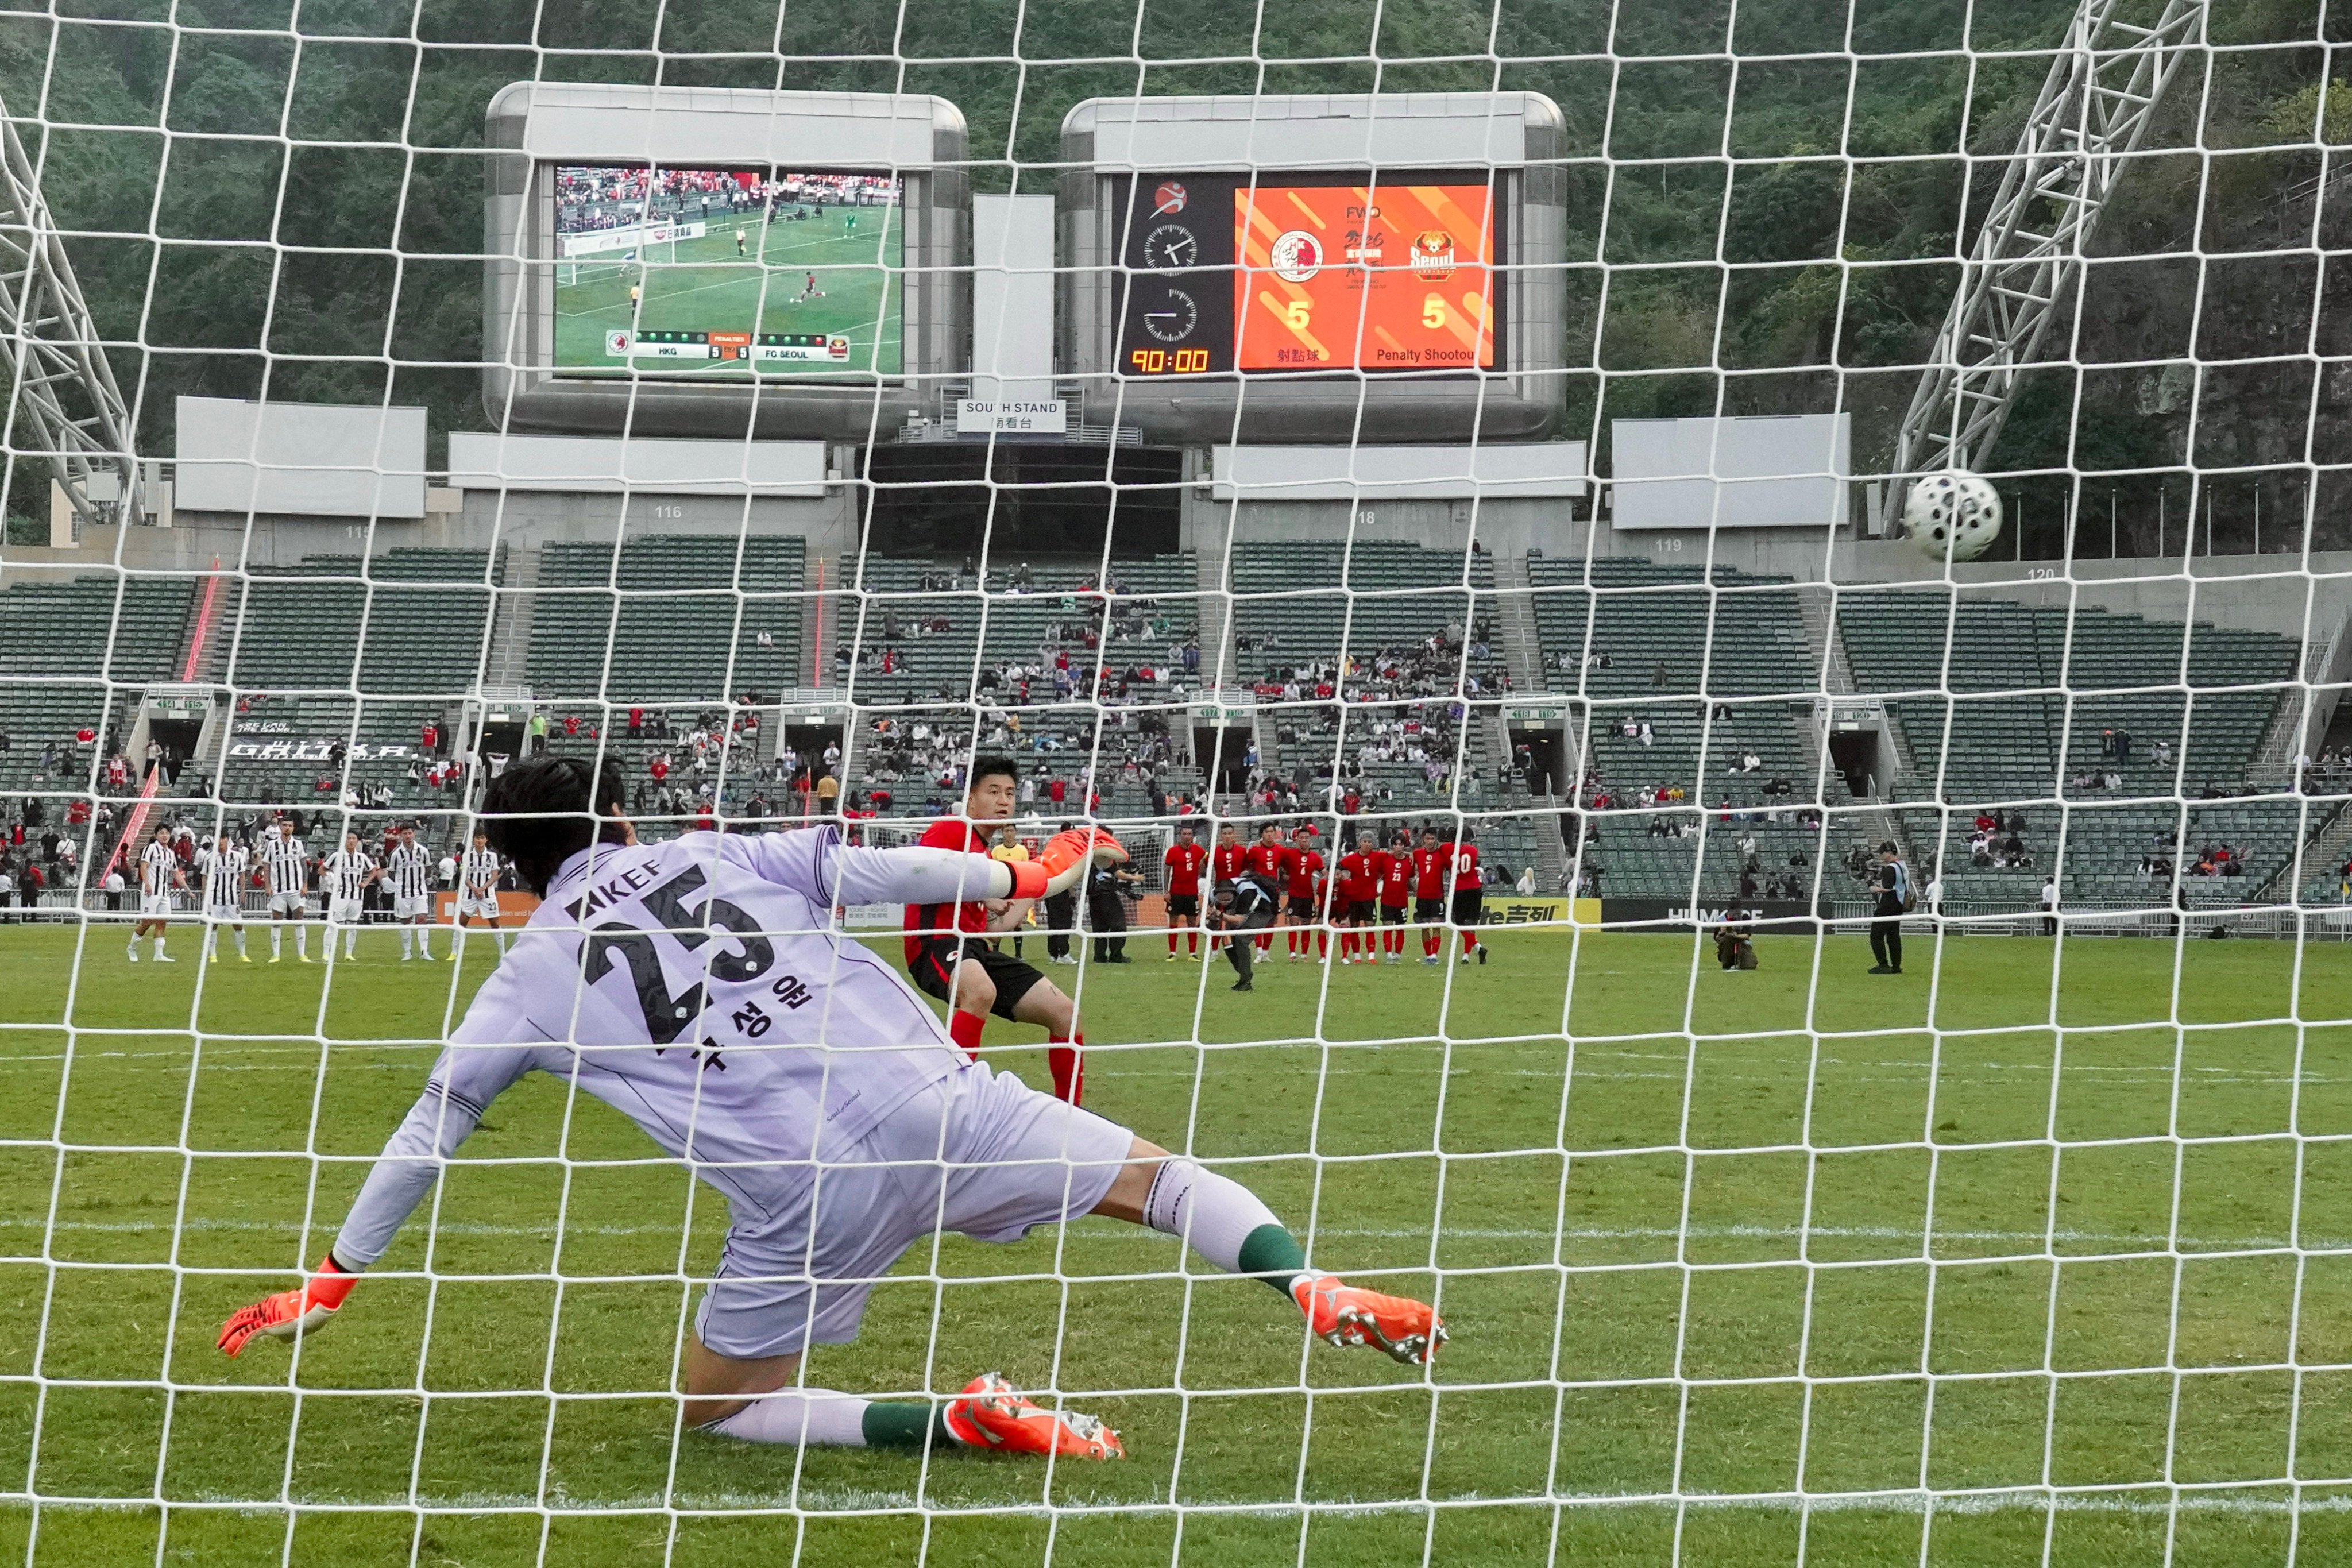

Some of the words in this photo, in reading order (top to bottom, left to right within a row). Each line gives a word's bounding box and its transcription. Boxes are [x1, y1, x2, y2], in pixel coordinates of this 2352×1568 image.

[1287, 301, 1310, 329] 5
[1422, 300, 1445, 329] 5
[659, 347, 677, 356] HKG
[712, 346, 719, 358] 5
[739, 346, 747, 358] 5
[780, 350, 809, 359] SEOUL
[1277, 349, 1319, 362] 射點球
[1377, 349, 1420, 363] Penalty
[1425, 347, 1479, 361] Shootou
[1132, 350, 1207, 372] 90:00
[966, 403, 1010, 412] SOUH
[1014, 403, 1057, 413] STAND
[655, 505, 682, 519] 116
[1350, 511, 1376, 524] 18
[1655, 539, 1682, 552] 119
[2027, 568, 2054, 580] 120
[1227, 863, 1233, 872] 2
[1300, 867, 1306, 875] 6
[1426, 865, 1431, 874] 9
[1392, 873, 1401, 882] 23
[488, 902, 497, 911] 22
[578, 863, 775, 1056] 25
[690, 975, 813, 1072] 구성윤
